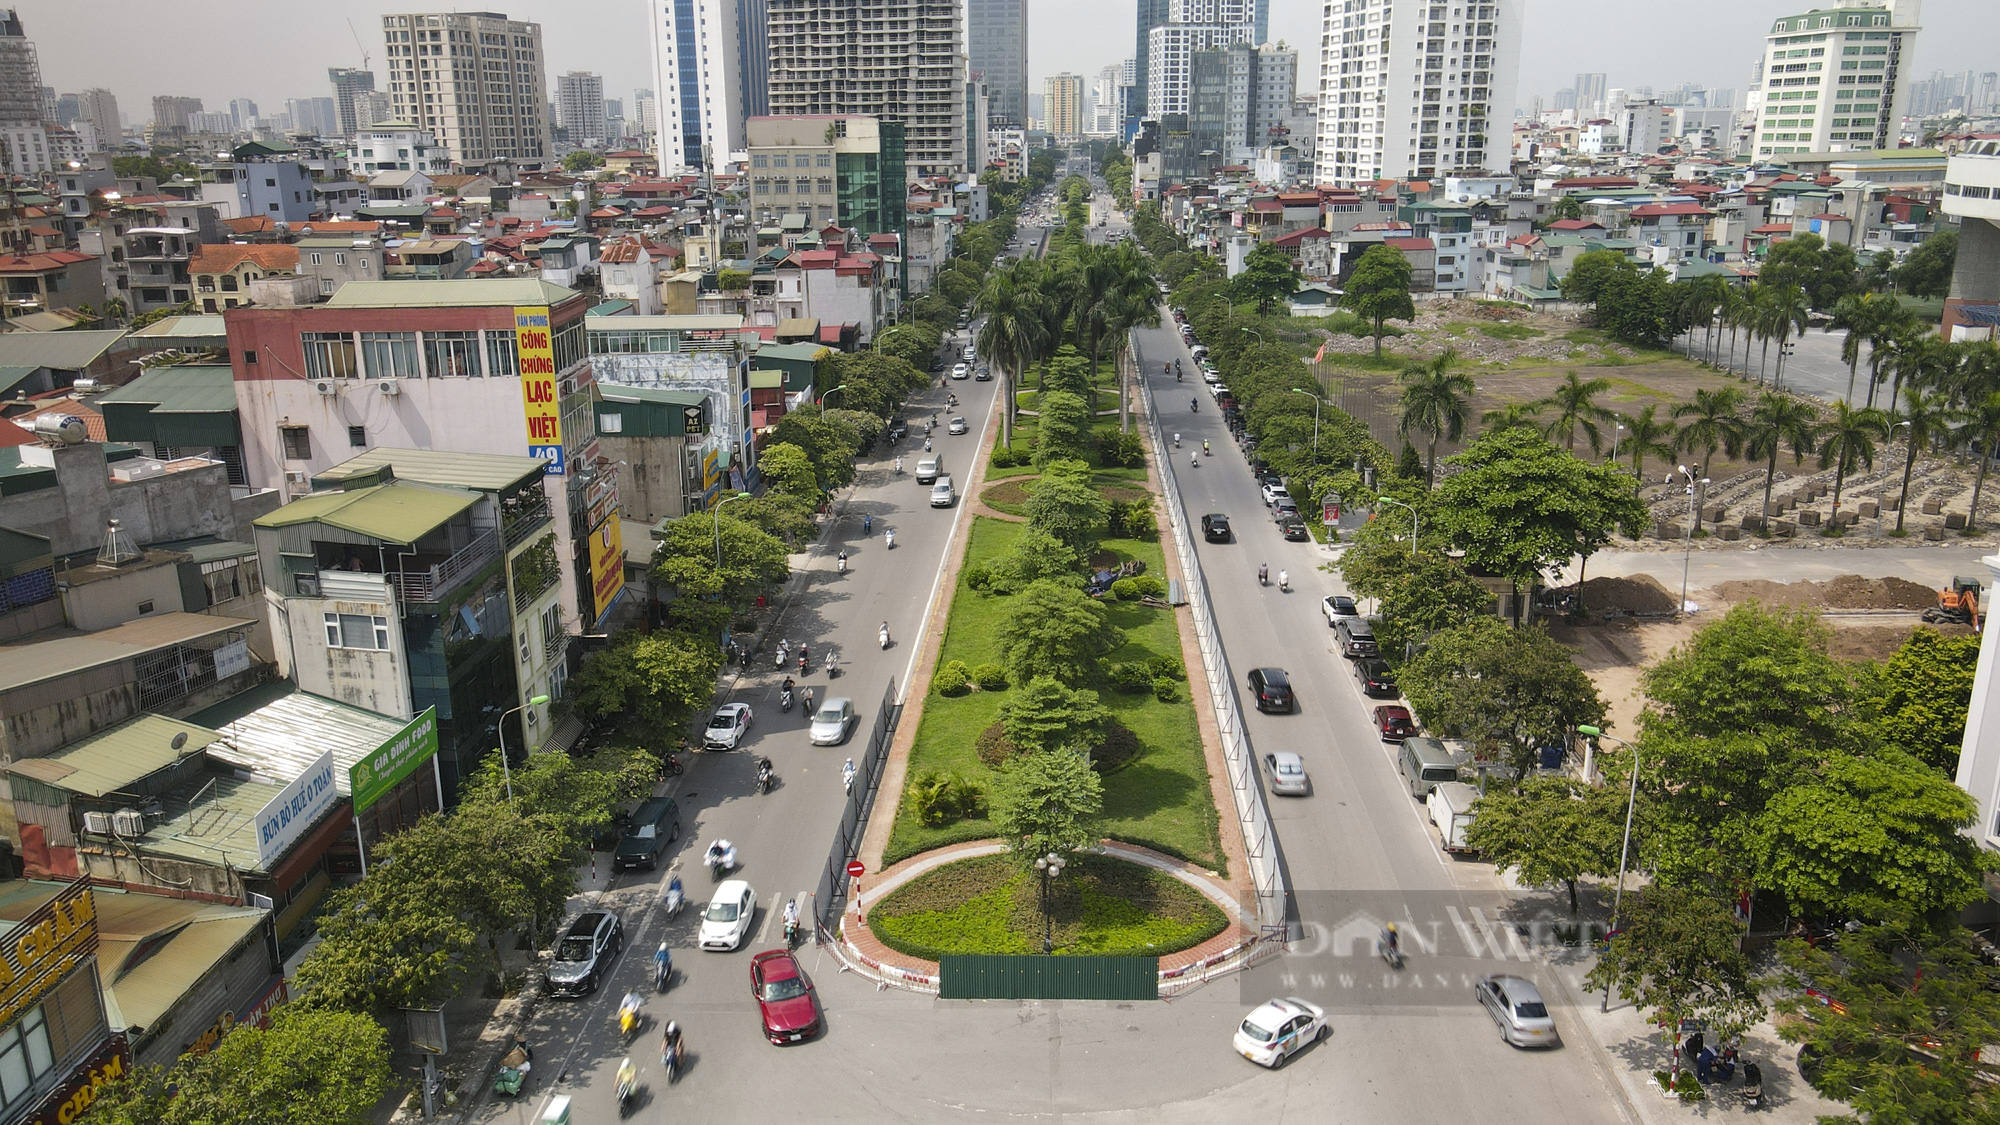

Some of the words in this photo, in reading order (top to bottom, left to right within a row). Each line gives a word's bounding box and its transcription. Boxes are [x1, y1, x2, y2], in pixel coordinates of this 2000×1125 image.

[516, 313, 528, 327] VĂN
[528, 312, 548, 327] PHÒNG
[521, 329, 548, 349] CÔNG
[520, 355, 553, 374] CHỨNG
[526, 380, 553, 408] LẠC
[528, 412, 557, 443] VIỆT
[535, 447, 558, 464] 49
[374, 752, 389, 772] GIA
[390, 735, 410, 760] ĐÌNH
[411, 719, 432, 743] FOOD
[262, 814, 281, 845] BÚN
[280, 801, 291, 829] BÒ
[291, 780, 308, 818] HUẾ
[307, 784, 313, 802] O
[312, 765, 332, 797] TOÀN
[17, 890, 94, 968] CHÂM
